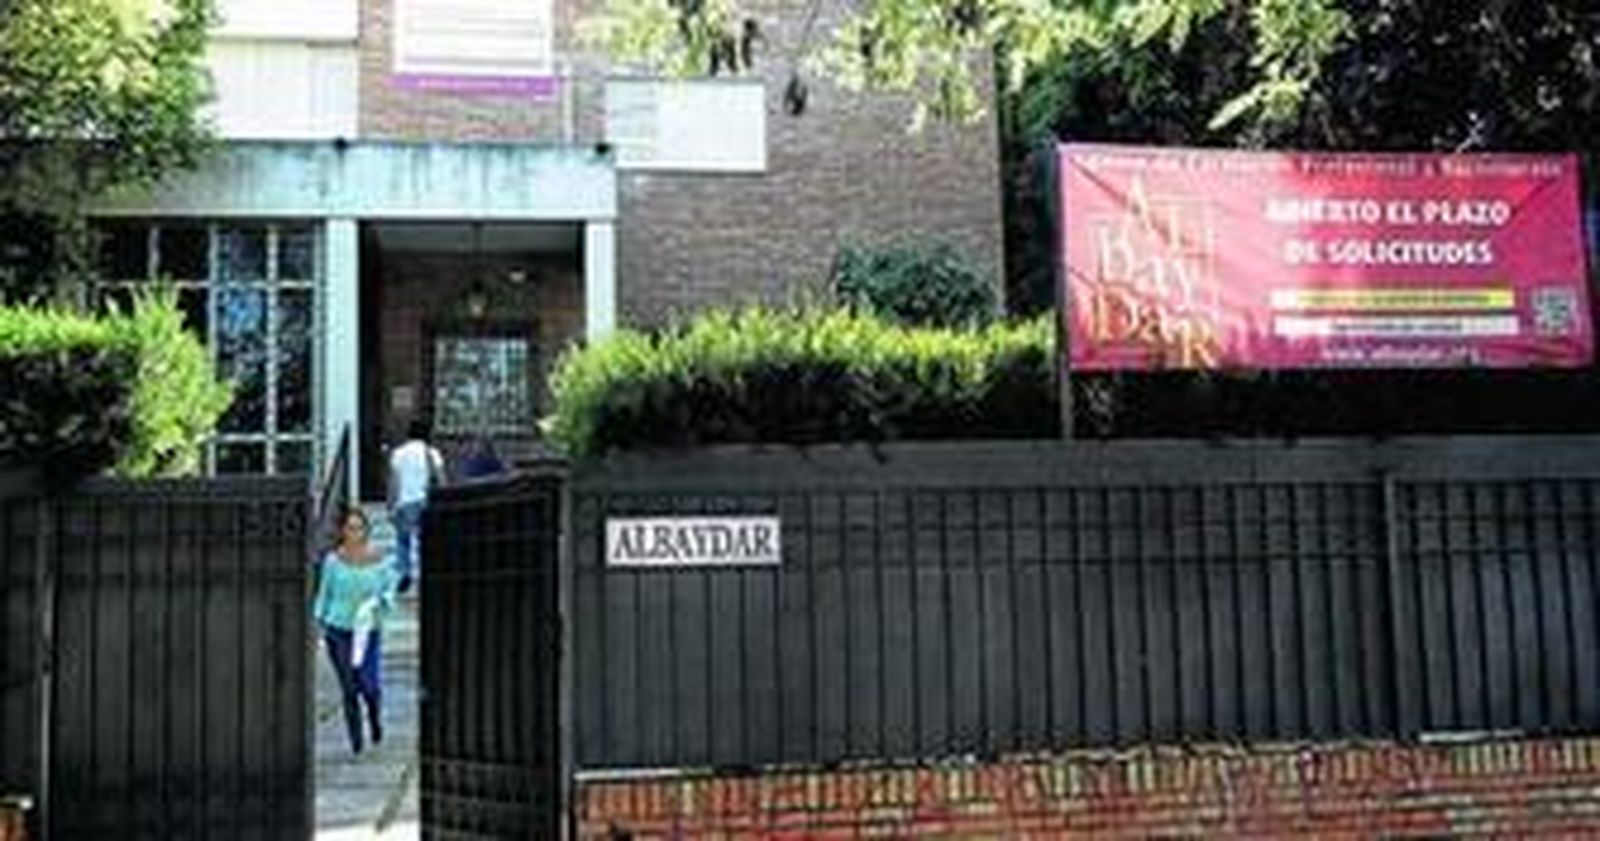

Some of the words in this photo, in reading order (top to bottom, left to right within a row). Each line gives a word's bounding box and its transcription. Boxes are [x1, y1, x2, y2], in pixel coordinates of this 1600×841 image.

[1387, 200, 1419, 225] EL
[1424, 200, 1511, 226] PLAZO
[1284, 239, 1322, 264] DE
[1327, 239, 1495, 265] SOLICITUDES
[613, 523, 772, 560] ALBAYDAR
